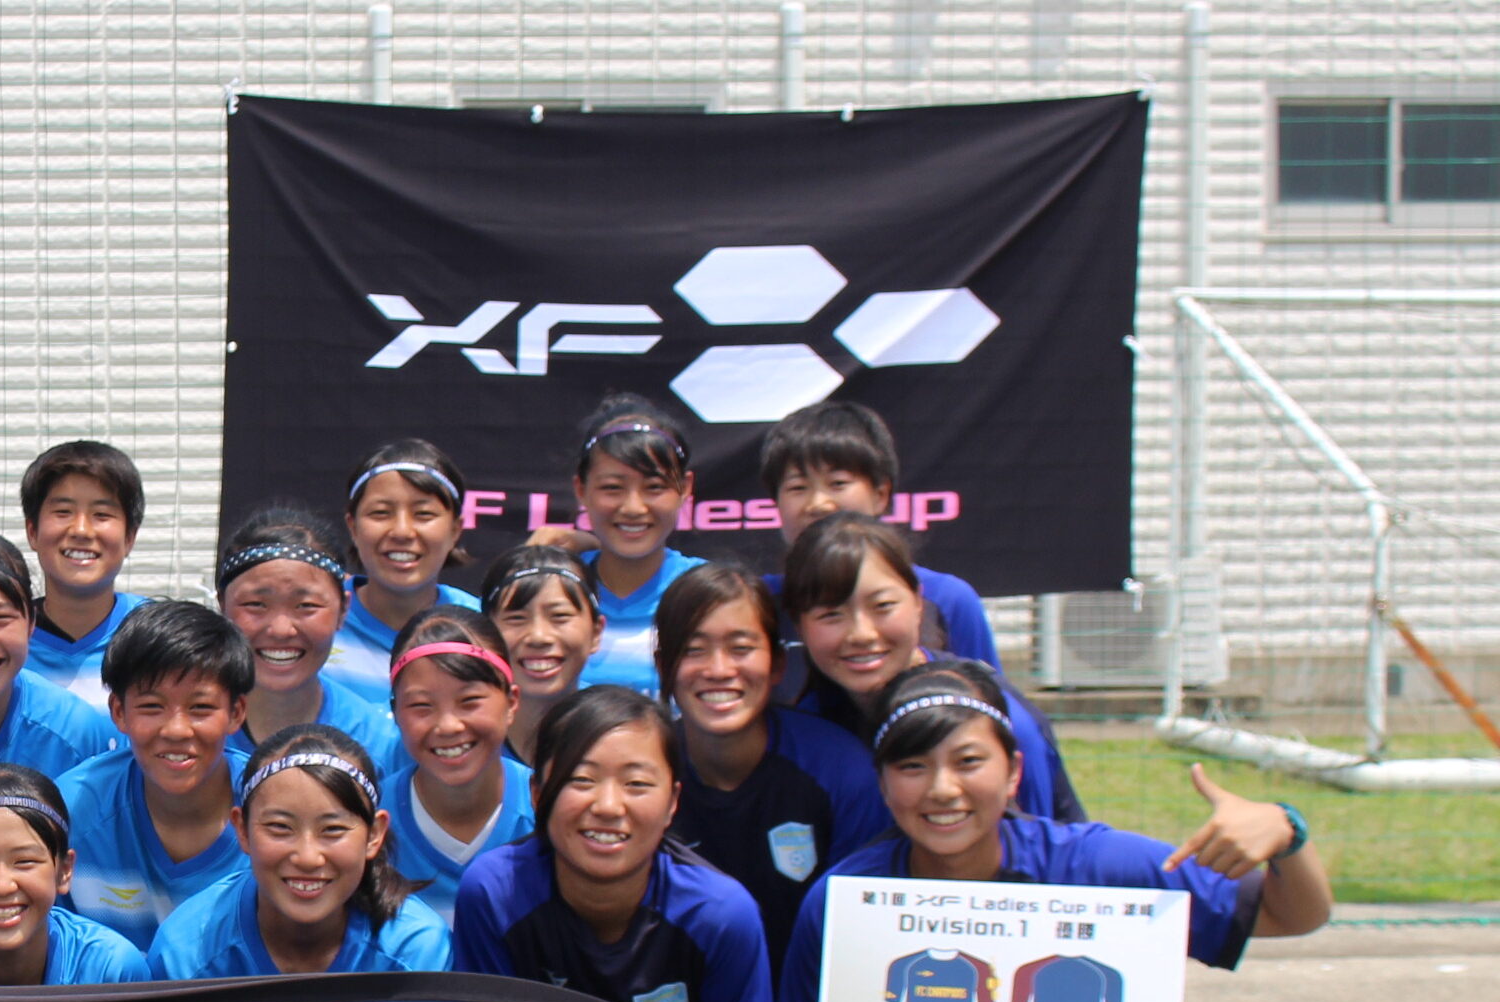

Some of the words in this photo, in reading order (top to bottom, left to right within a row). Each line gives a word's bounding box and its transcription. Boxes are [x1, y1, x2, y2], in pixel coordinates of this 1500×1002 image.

[366, 293, 662, 375] XF
[462, 490, 506, 529] F
[970, 896, 1039, 912] Ladies
[1049, 900, 1087, 915] Cup
